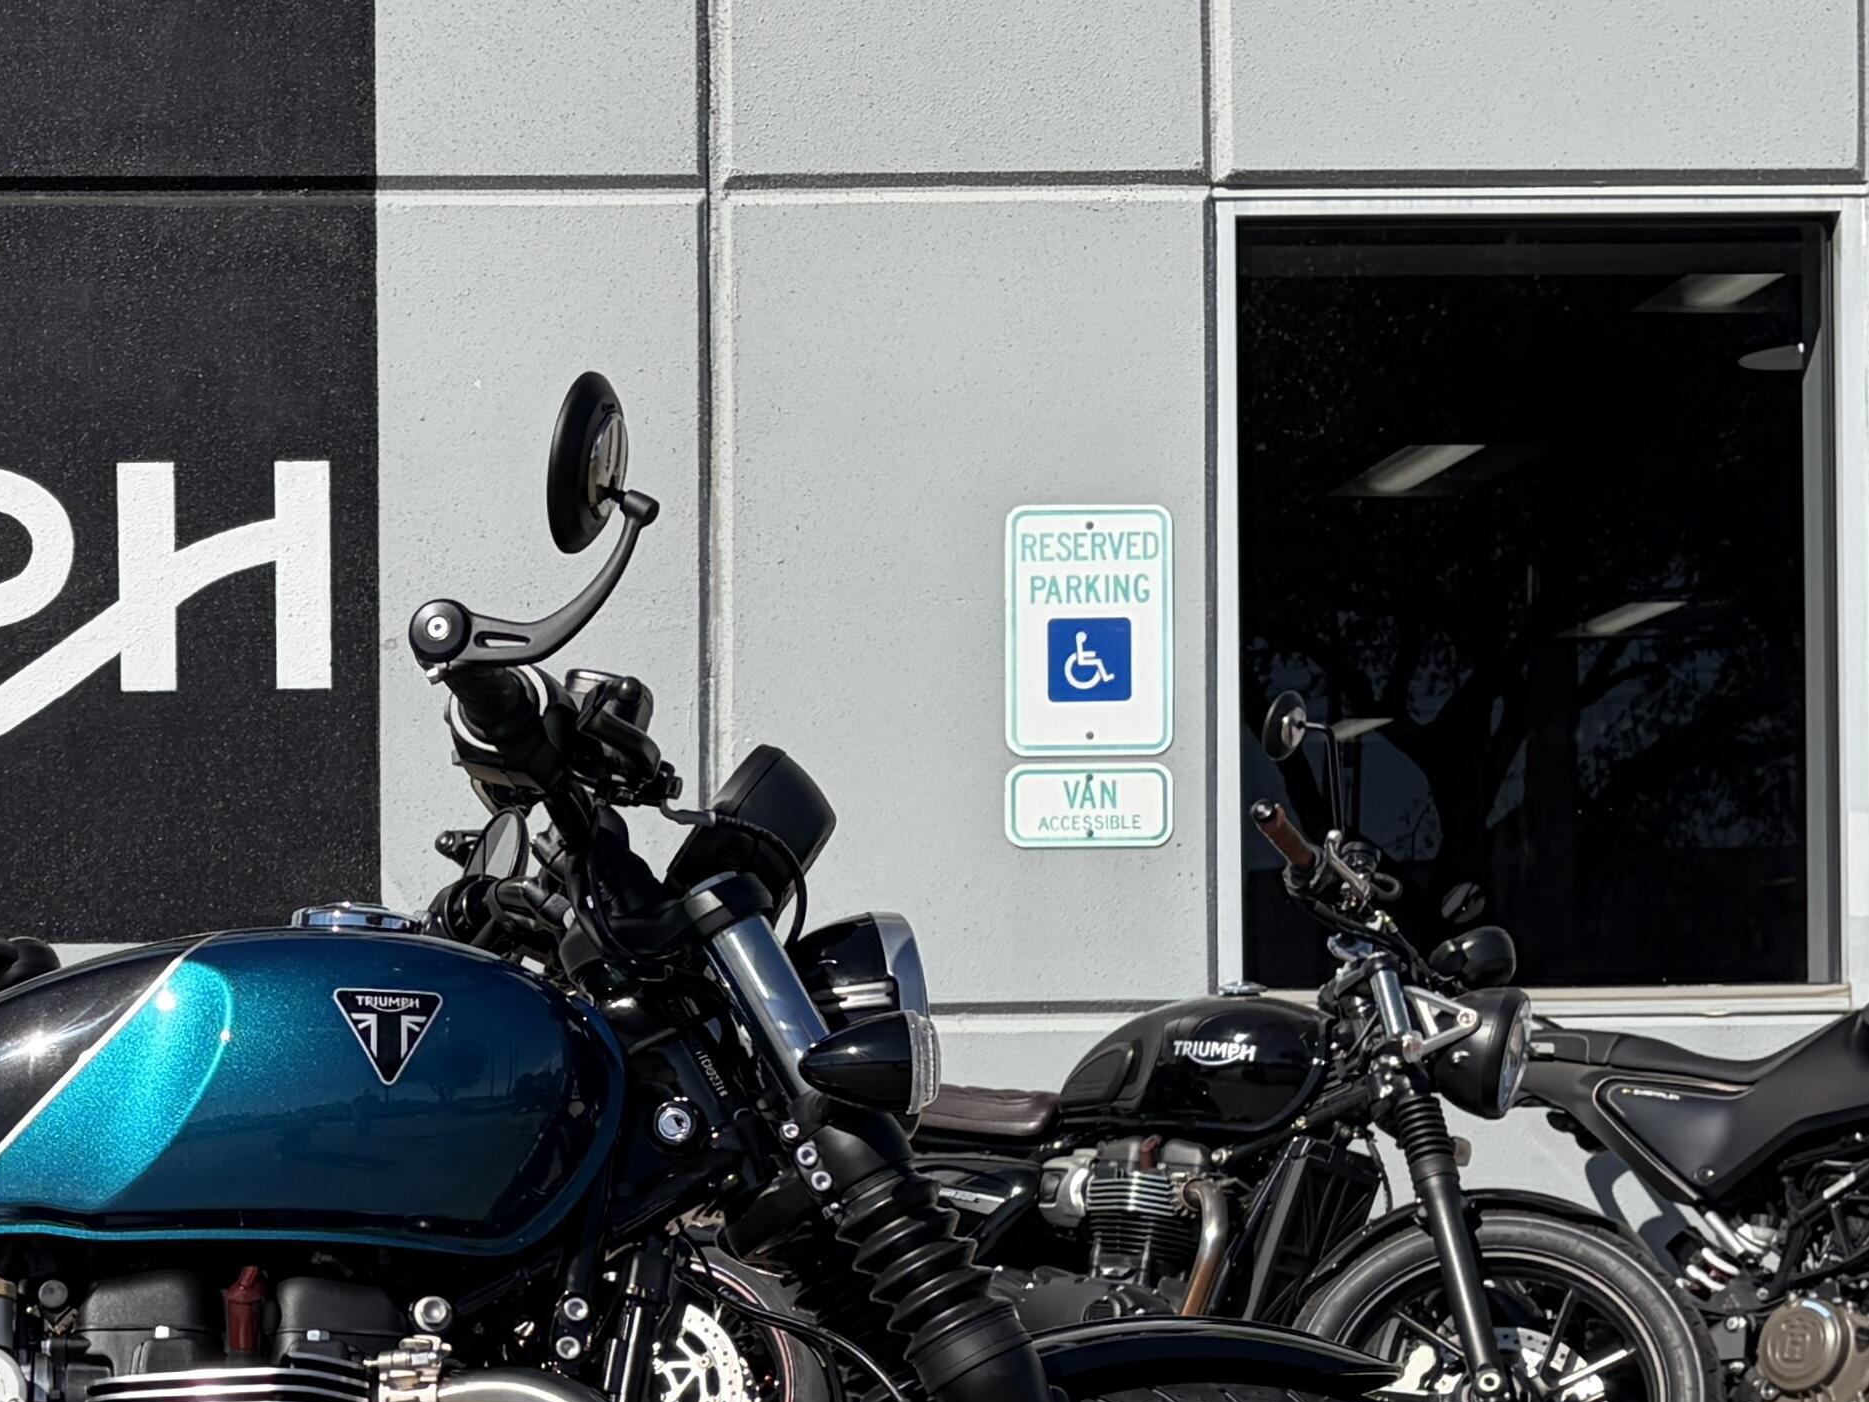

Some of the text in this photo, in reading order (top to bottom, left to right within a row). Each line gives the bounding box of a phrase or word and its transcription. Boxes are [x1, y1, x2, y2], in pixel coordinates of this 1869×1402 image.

[1020, 531, 1160, 562] RESERVED
[1030, 573, 1151, 604] PARKING
[1063, 780, 1118, 810] VAN
[1037, 815, 1142, 833] ACCESSIBLE
[355, 995, 420, 1012] TRIUMPH
[1173, 1040, 1257, 1066] TRIUMPH
